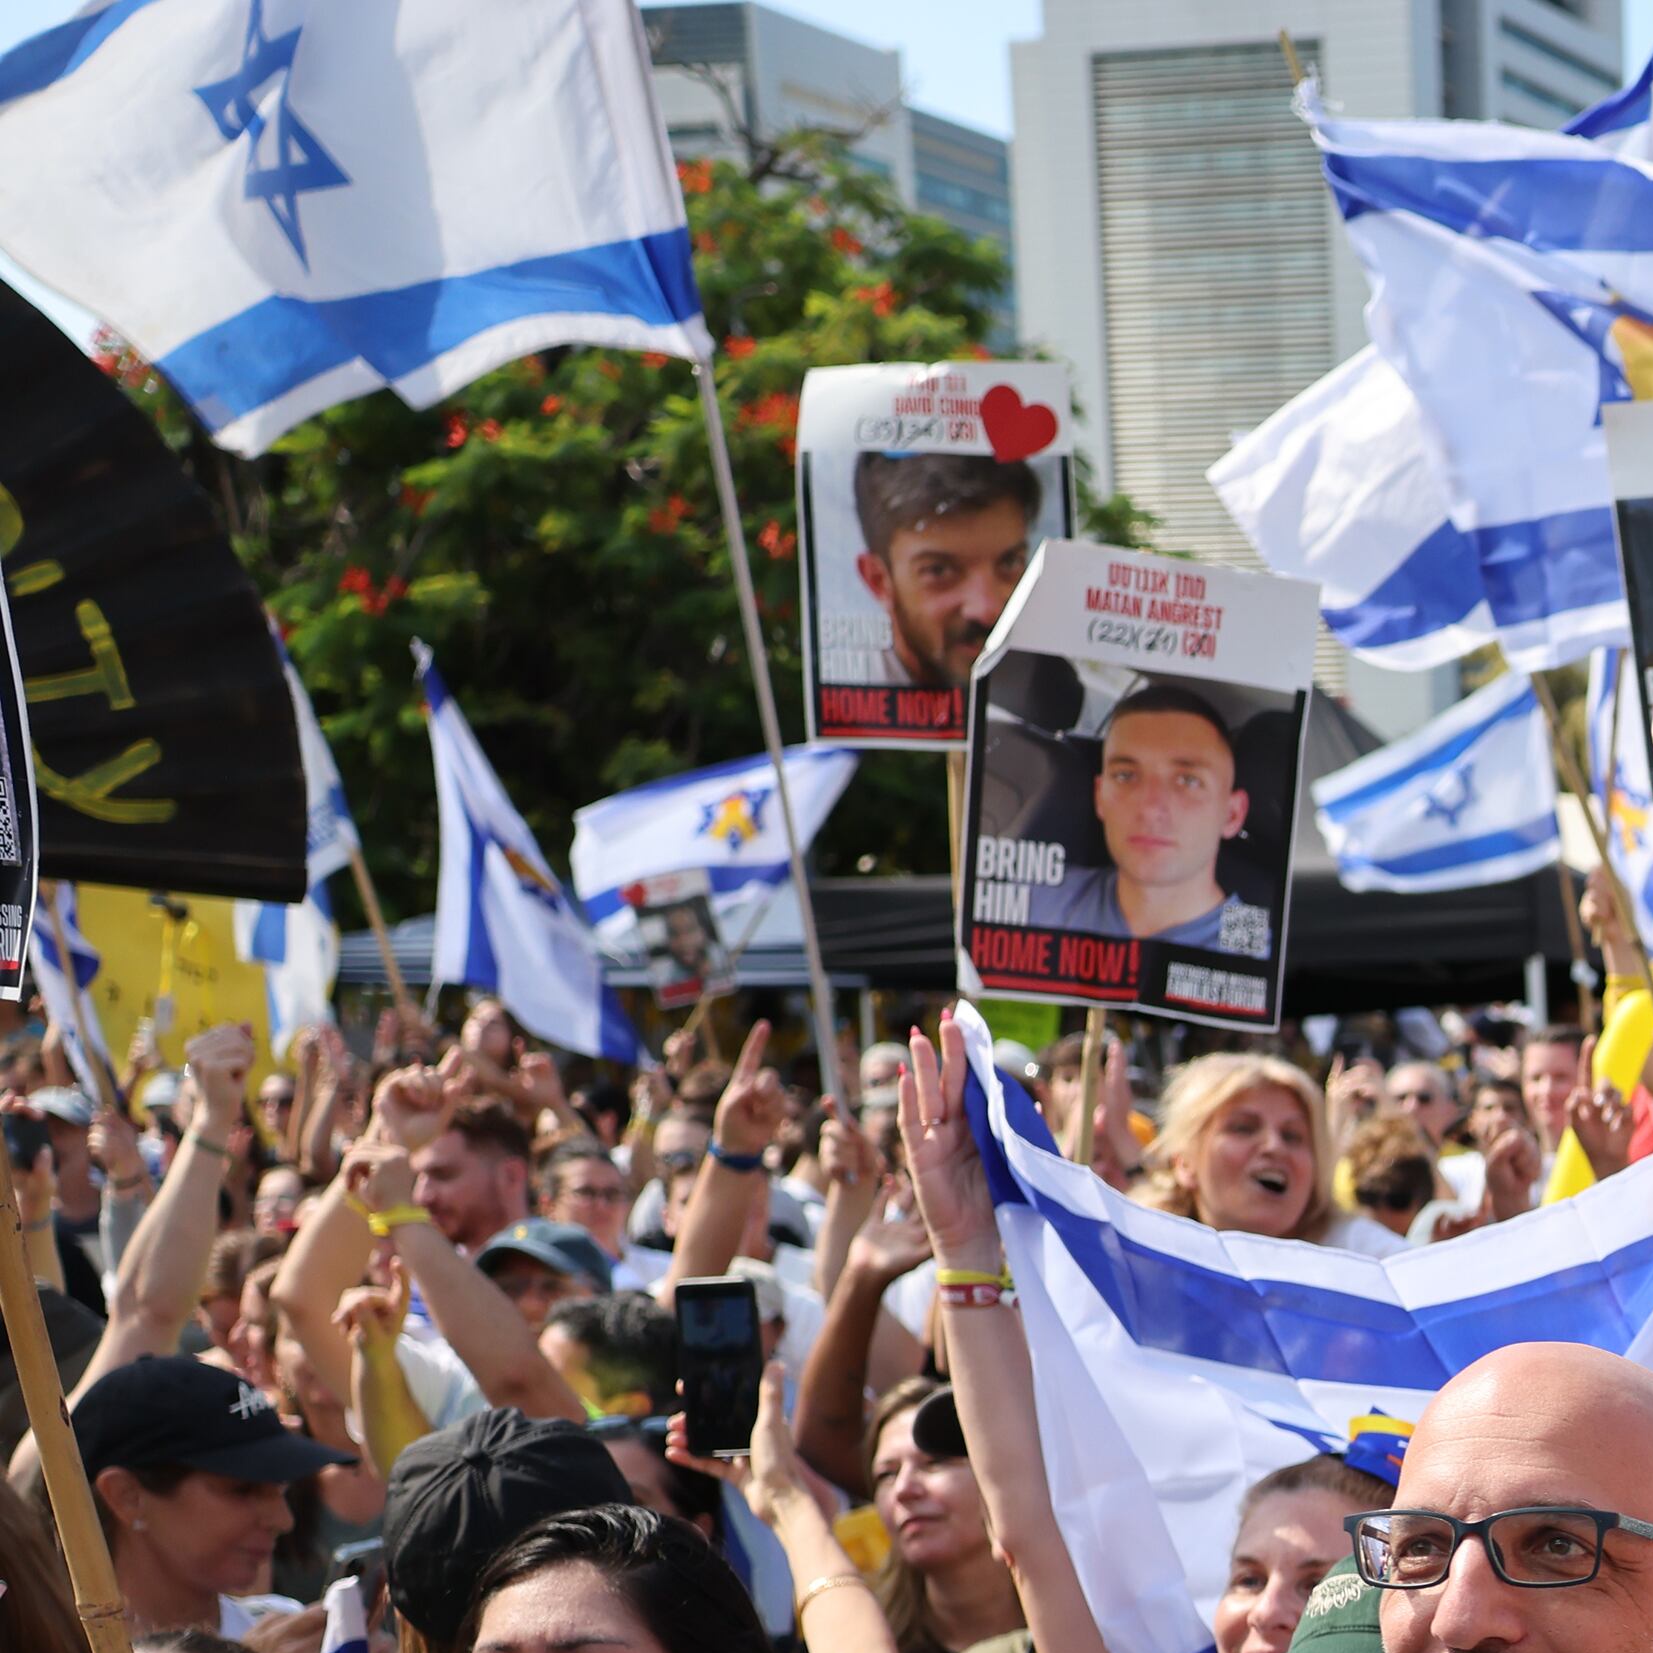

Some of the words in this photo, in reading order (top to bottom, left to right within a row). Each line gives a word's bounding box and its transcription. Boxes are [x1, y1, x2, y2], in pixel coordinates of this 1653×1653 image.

[896, 398, 934, 416] DAVID
[1086, 588, 1142, 618] MATAN
[1146, 600, 1224, 631] ANGREST
[823, 615, 892, 650] BRING
[821, 650, 869, 684] HIM
[821, 688, 892, 724] HOME
[897, 686, 963, 726] NOW!
[977, 836, 1066, 886] BRING
[973, 880, 1030, 926] HIM
[971, 926, 1053, 976] HOME
[1058, 937, 1142, 985] NOW!
